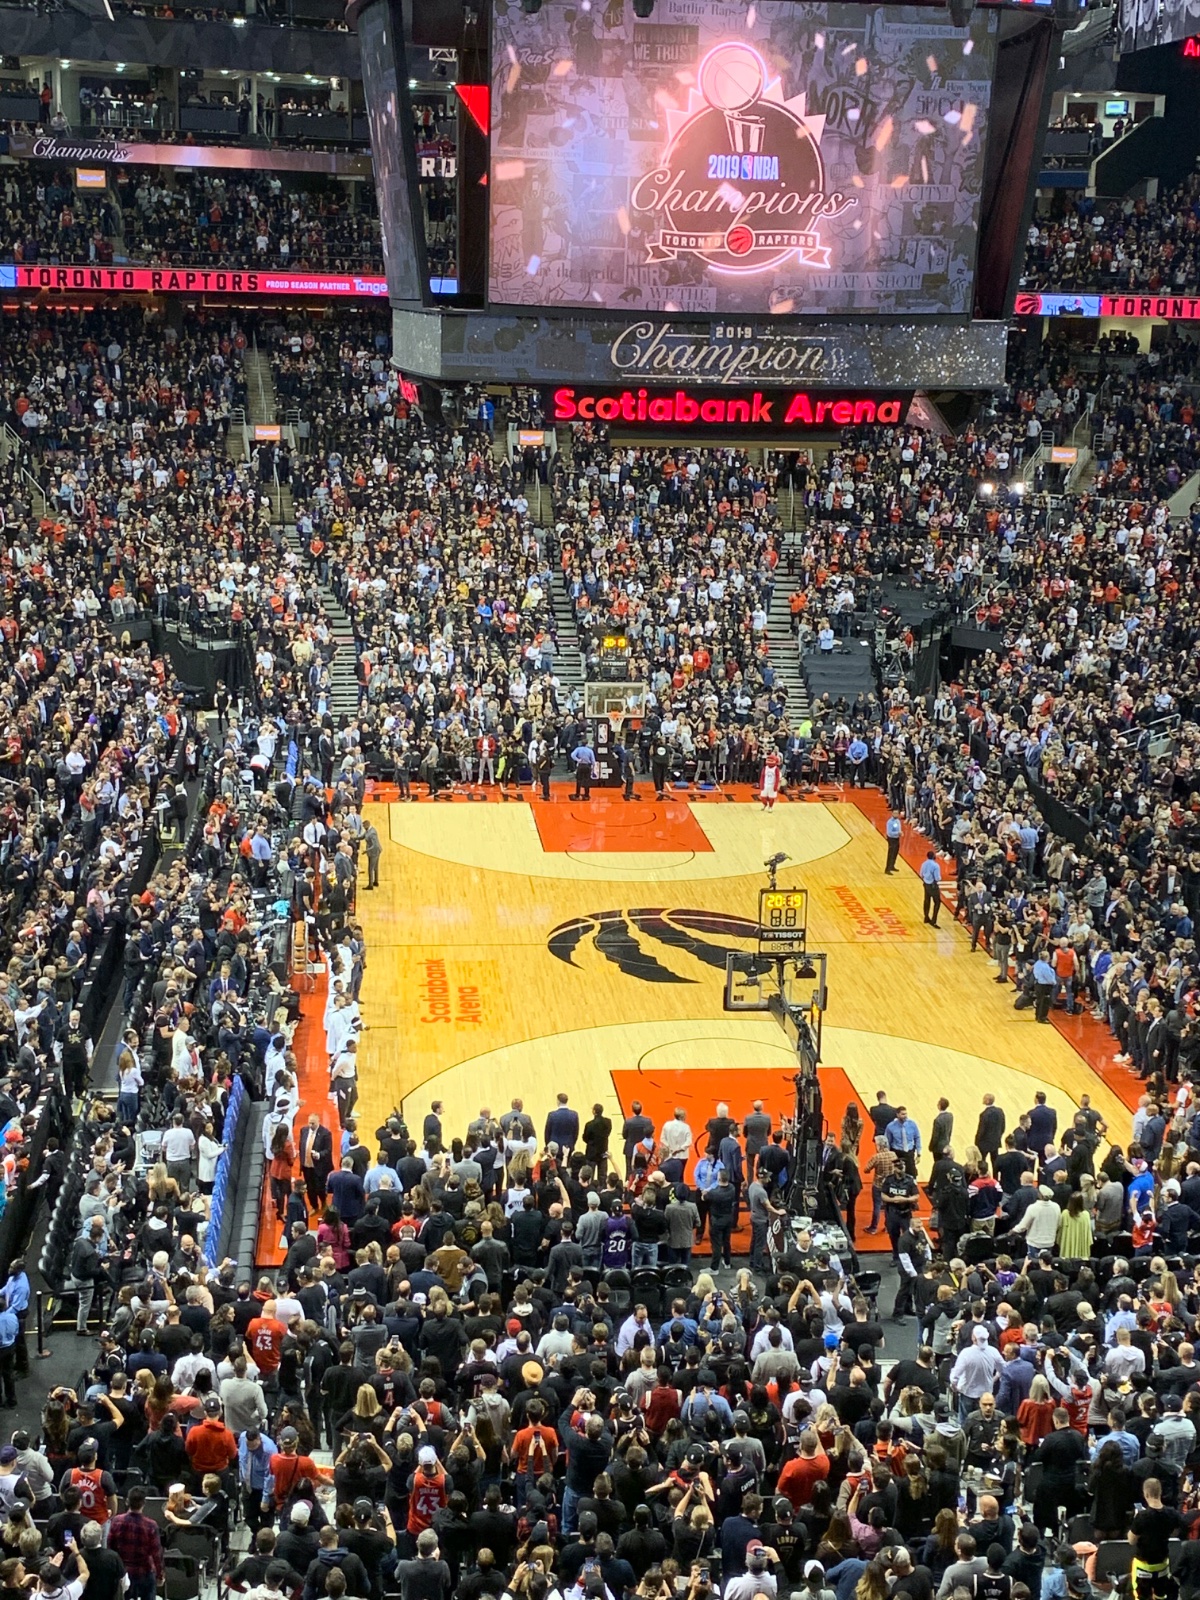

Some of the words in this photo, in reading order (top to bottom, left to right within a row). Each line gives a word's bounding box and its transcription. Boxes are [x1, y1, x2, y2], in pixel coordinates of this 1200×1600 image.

[633, 43, 650, 60] WE
[655, 44, 698, 61] TRUST
[32, 136, 134, 161] Champions
[708, 155, 739, 179] 2019
[753, 156, 778, 180] NBA
[631, 168, 858, 229] Champions
[665, 234, 722, 248] TORONTO
[759, 233, 814, 247] RAPTORS
[24, 268, 134, 288] TORONTO
[152, 272, 258, 292] RAPTORS
[265, 280, 289, 289] PROUD
[290, 281, 318, 290] SEASON
[319, 282, 350, 291] PARTNER
[811, 275, 858, 288] WHAT
[876, 276, 922, 289] SHOT!
[677, 287, 710, 301] THE
[715, 326, 753, 339] 2019
[610, 321, 850, 384] Champions
[554, 387, 773, 423] Scotiabank
[784, 393, 902, 424] Arena
[416, 958, 452, 1024] Scotiabank
[455, 986, 483, 1025] Arena
[889, 1186, 907, 1196] POLICE
[608, 1239, 626, 1252] 20
[256, 1335, 272, 1350] 43
[417, 1496, 440, 1515] 43
